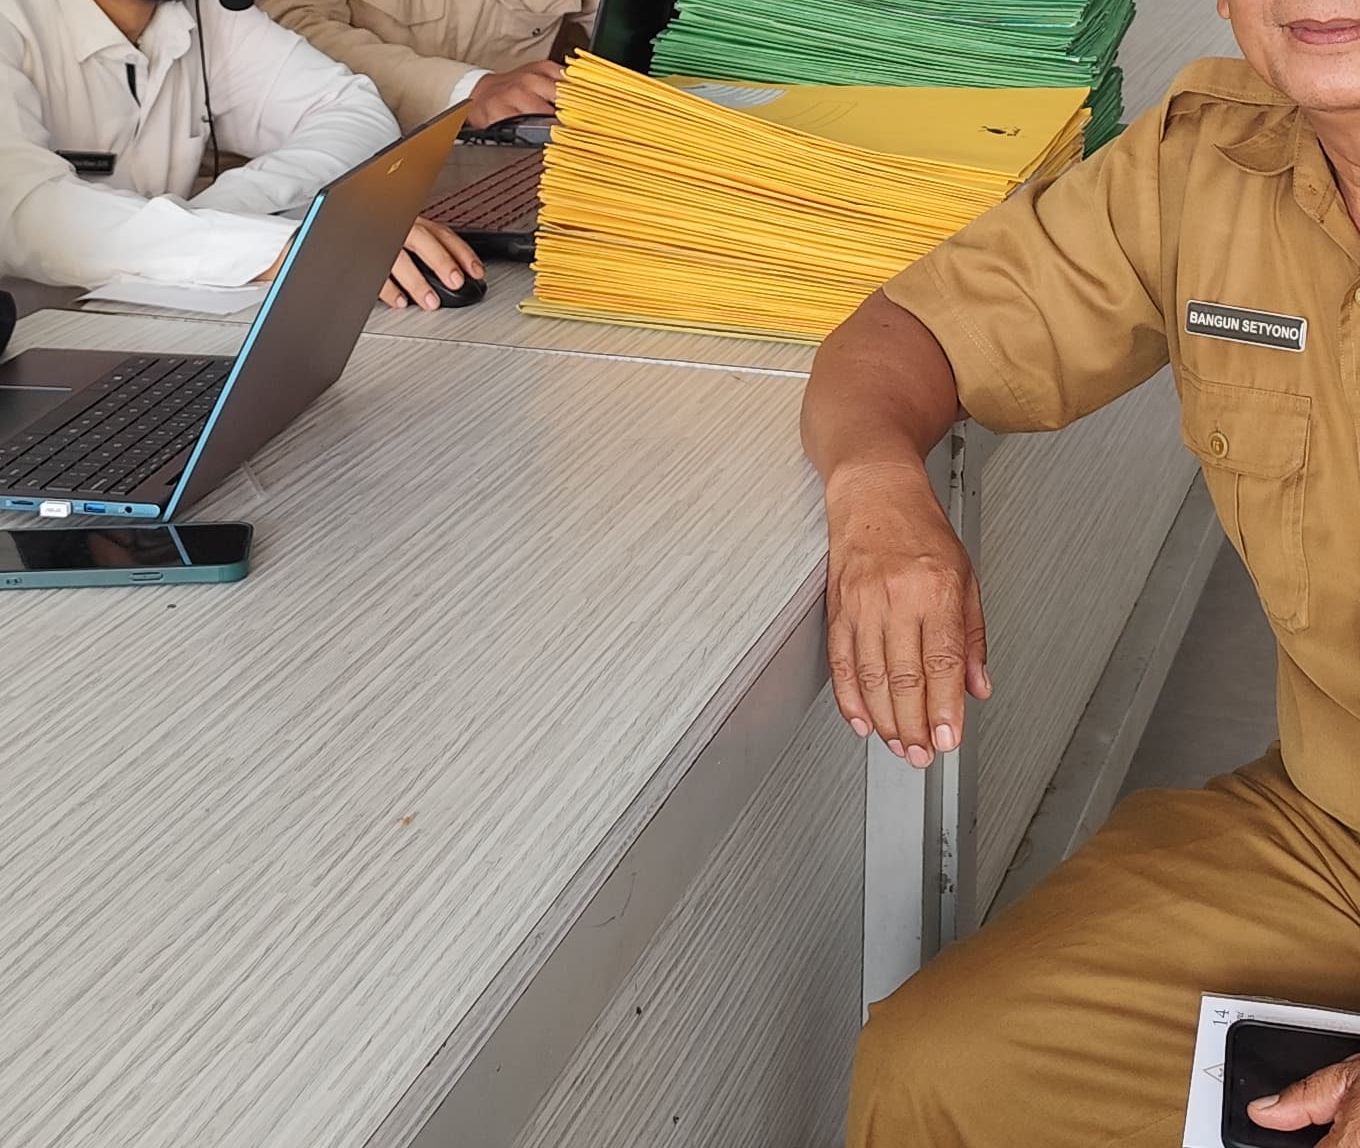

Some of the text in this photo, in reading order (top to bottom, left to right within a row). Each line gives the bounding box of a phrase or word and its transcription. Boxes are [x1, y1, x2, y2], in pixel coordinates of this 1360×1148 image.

[1189, 311, 1299, 341] BANGUN SETYONO
[1213, 1009, 1229, 1026] 14
